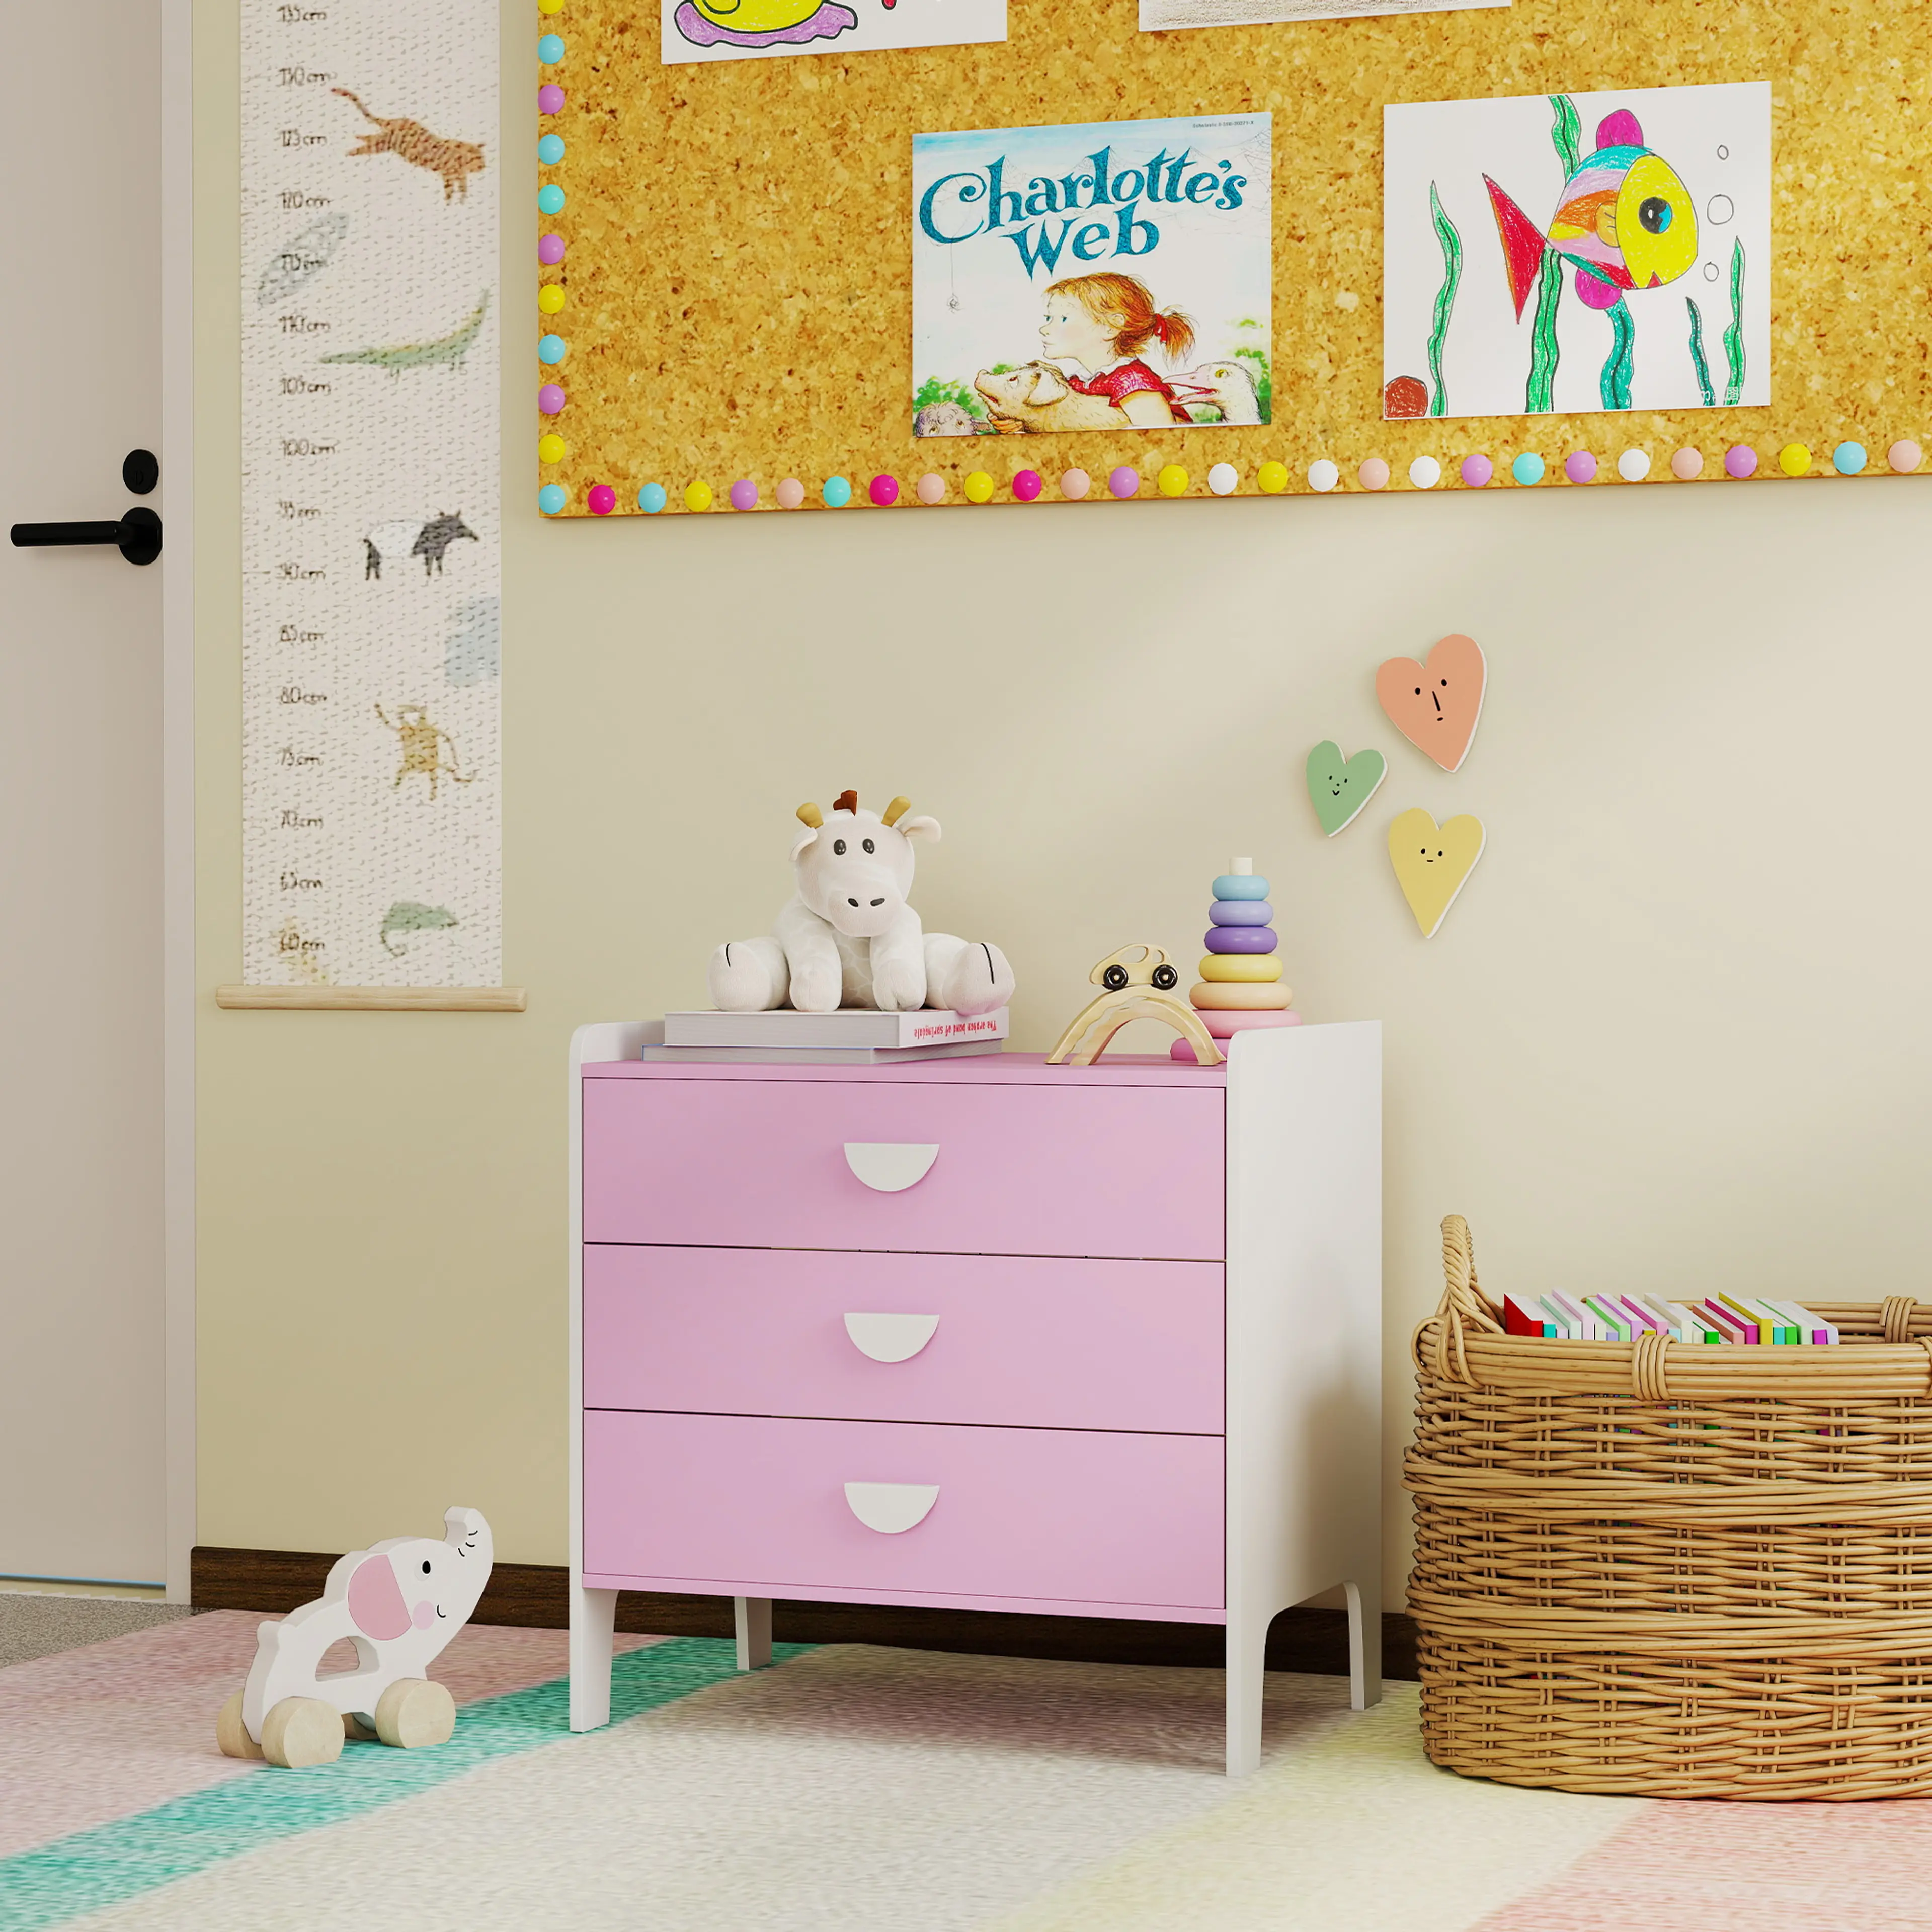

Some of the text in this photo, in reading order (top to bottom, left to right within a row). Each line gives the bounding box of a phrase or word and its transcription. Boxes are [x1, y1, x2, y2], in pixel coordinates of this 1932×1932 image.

[920, 145, 1247, 244] Charlotte's
[998, 200, 1160, 282] Web
[914, 1025, 943, 1039] springdale
[945, 1025, 951, 1037] of
[987, 1020, 997, 1031] The
